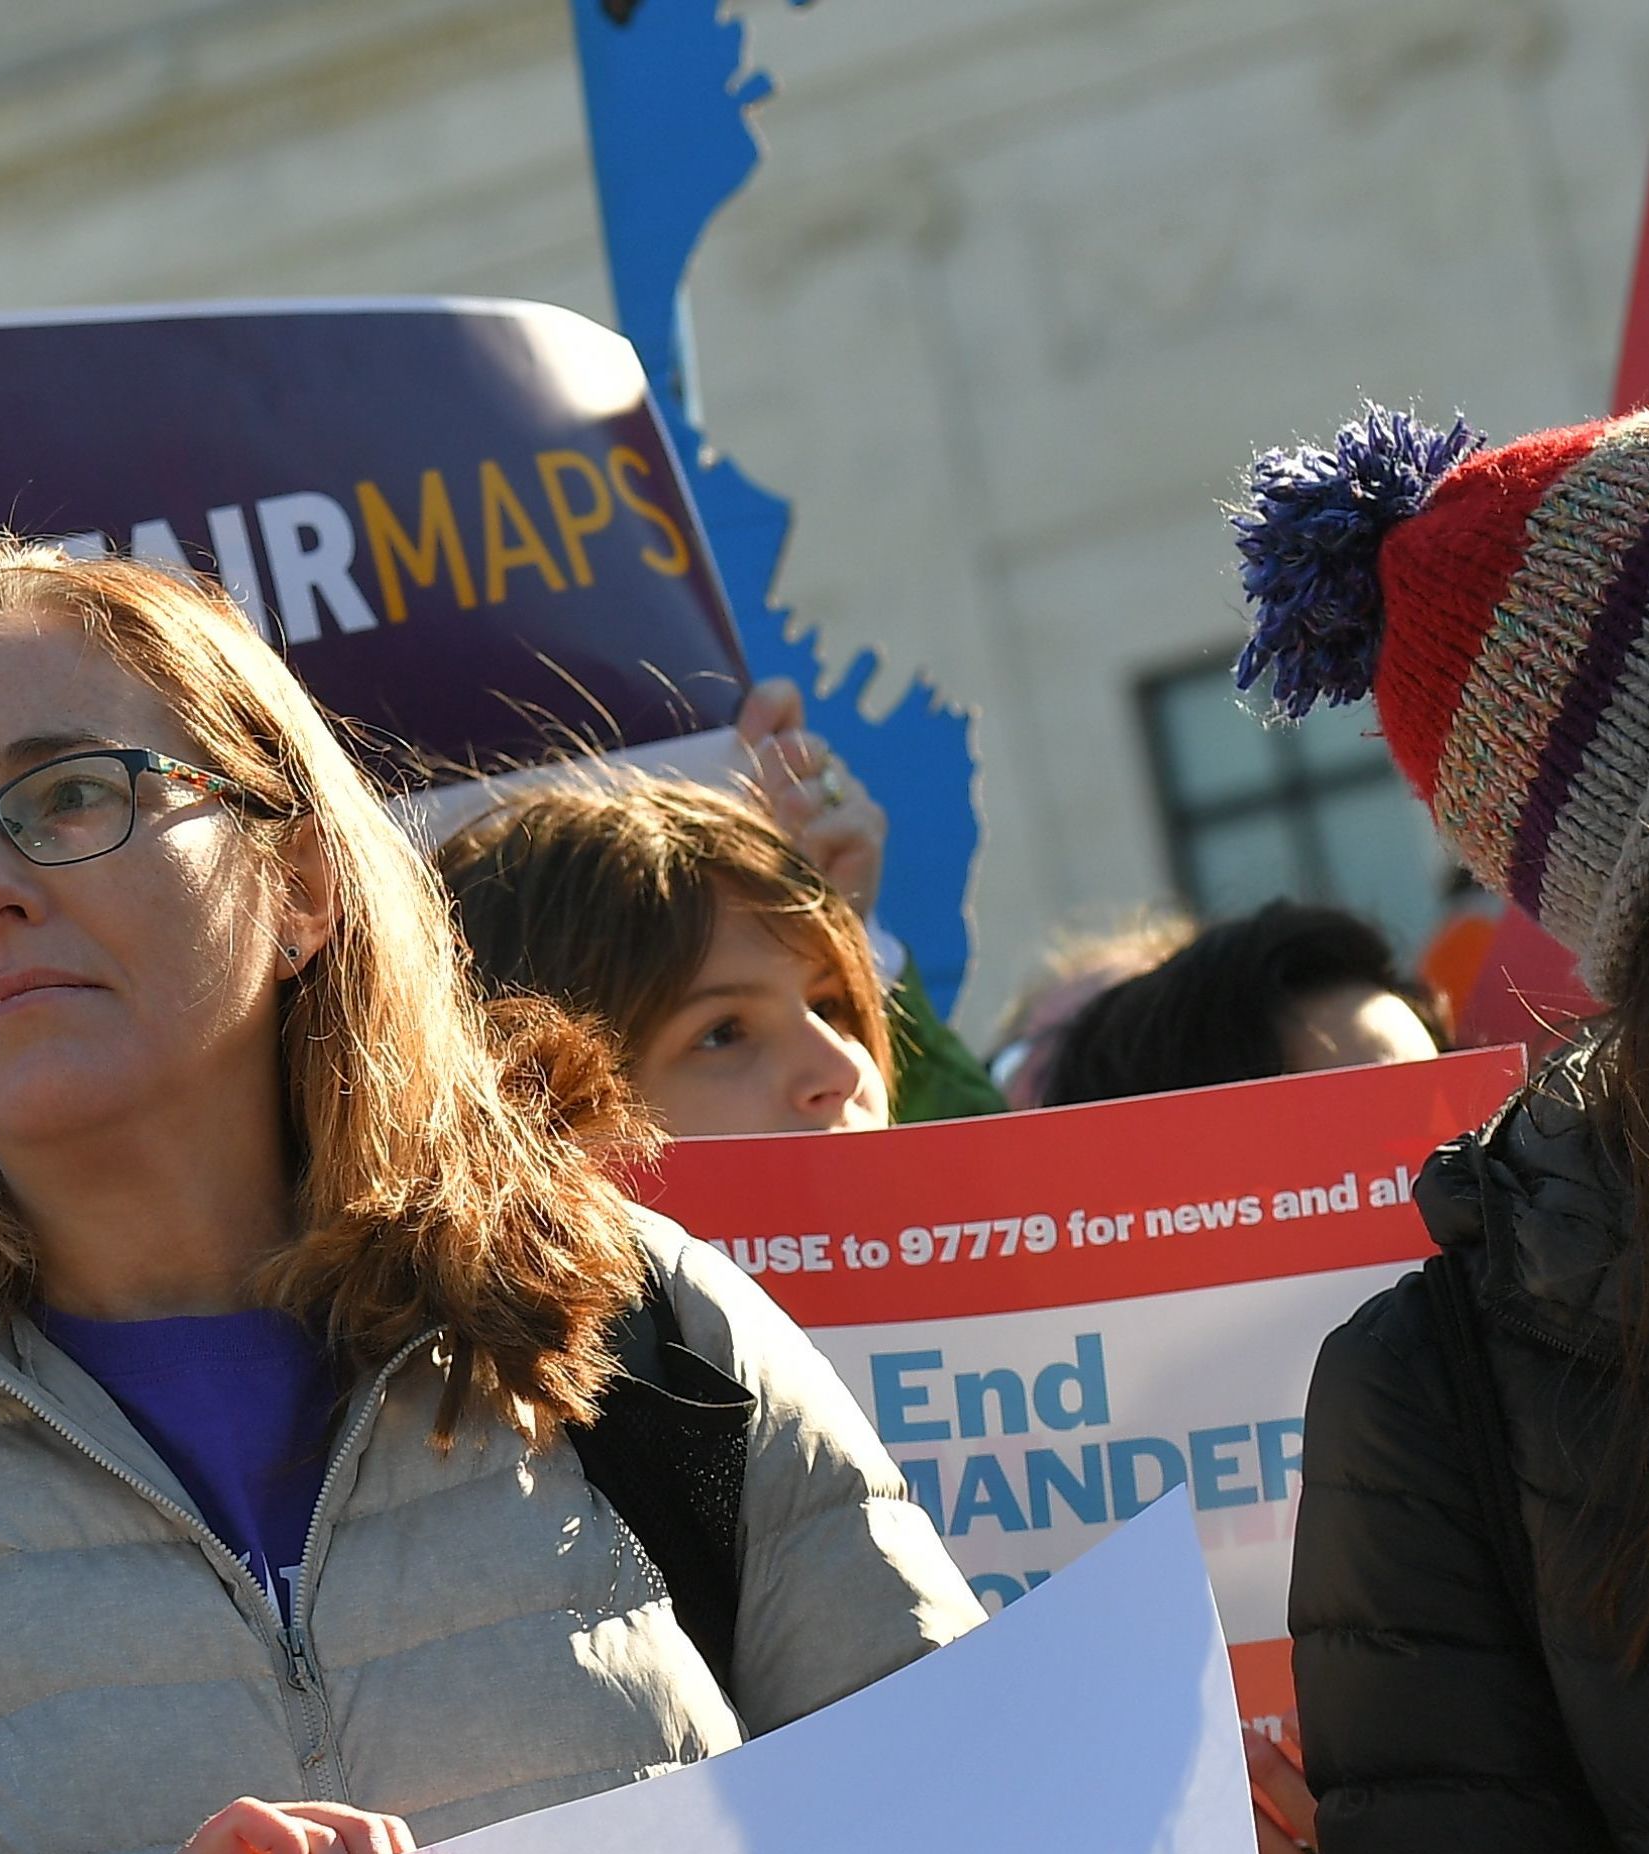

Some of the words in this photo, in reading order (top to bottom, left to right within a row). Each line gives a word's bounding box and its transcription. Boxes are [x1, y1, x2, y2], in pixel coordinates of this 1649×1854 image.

[47, 443, 690, 646] IRMAPS
[707, 1235, 834, 1275] USE
[842, 1234, 891, 1270] to
[897, 1212, 1058, 1267] 97779
[1066, 1208, 1136, 1249] for
[1144, 1193, 1264, 1239] news
[1271, 1171, 1360, 1223] and
[1368, 1165, 1420, 1209] al
[869, 1332, 1111, 1444] End
